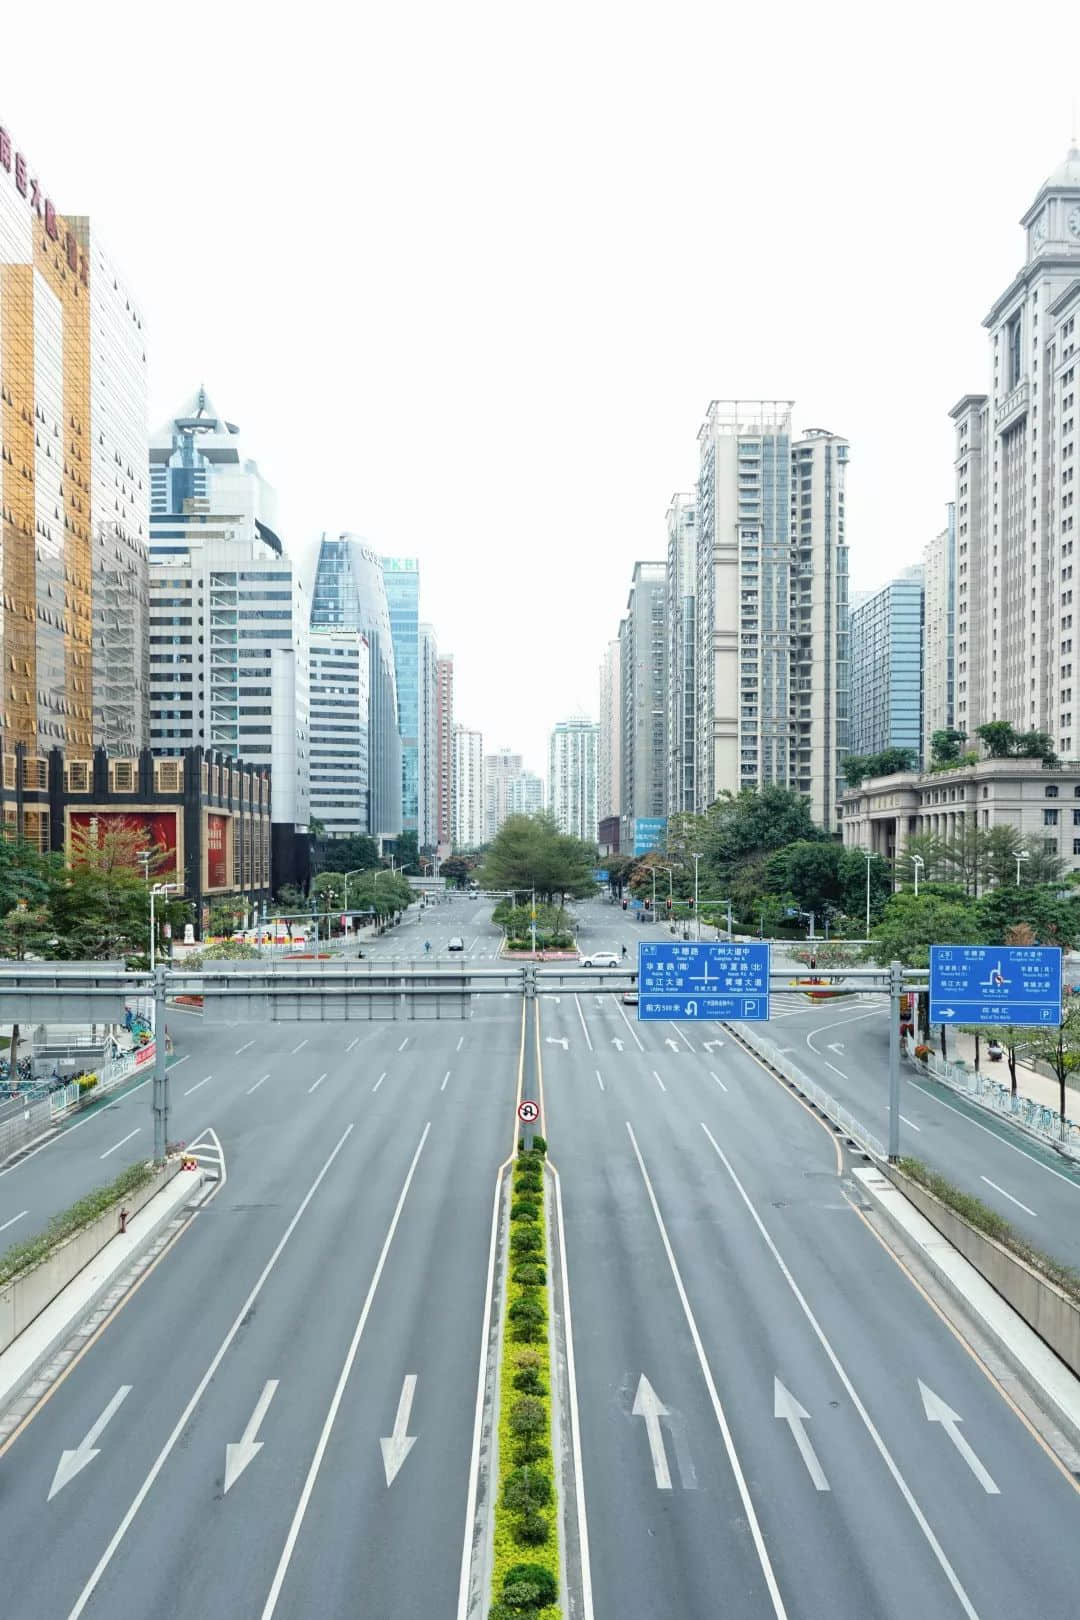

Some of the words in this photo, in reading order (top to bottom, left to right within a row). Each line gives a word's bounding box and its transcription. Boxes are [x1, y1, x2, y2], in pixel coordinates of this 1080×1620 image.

[709, 947, 750, 956] 广州大道中
[744, 1000, 756, 1015] P
